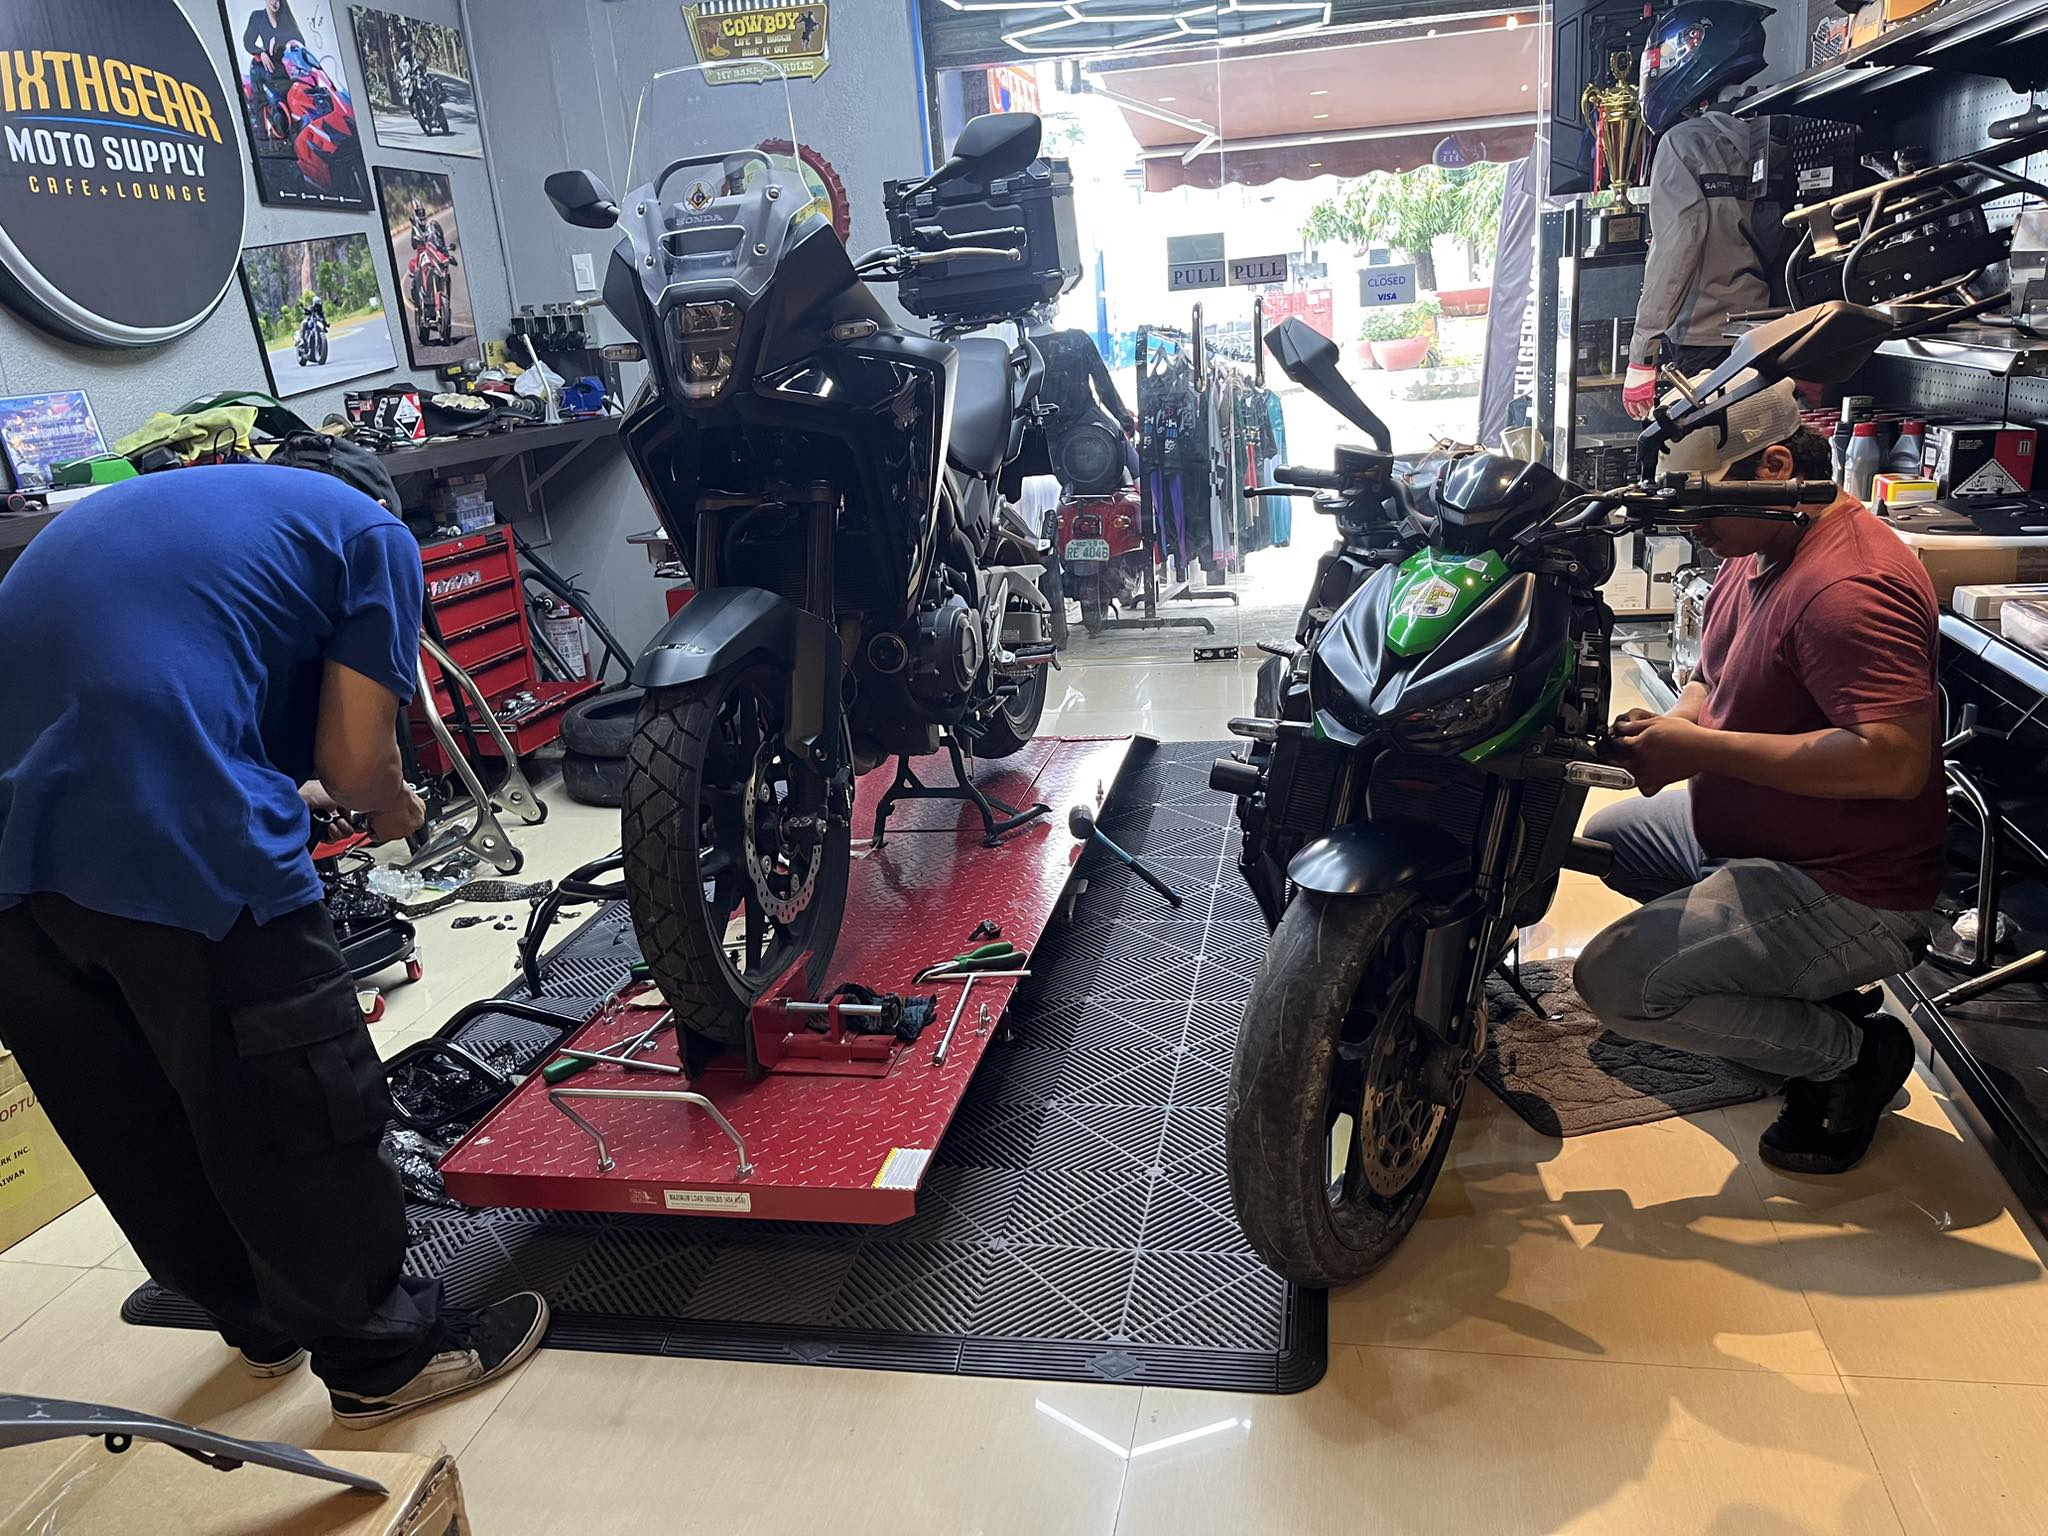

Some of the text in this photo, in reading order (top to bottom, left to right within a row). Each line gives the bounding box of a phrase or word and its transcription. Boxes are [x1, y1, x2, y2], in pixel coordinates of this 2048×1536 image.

[722, 12, 799, 37] COWBOY
[734, 37, 751, 47] LIFE
[755, 36, 763, 45] IS
[763, 46, 771, 55] IT
[774, 45, 789, 54] OUT
[0, 50, 223, 144] IXTHGEAR
[4, 125, 205, 177] MOTO SUPPLY
[676, 214, 723, 226] HONDA
[1174, 268, 1220, 285] PULL
[1234, 262, 1282, 279] PULL
[1367, 276, 1406, 288] CLOSED
[1378, 292, 1397, 301] VISA
[1067, 547, 1080, 558] RE
[0, 1094, 39, 1122] OPTU
[0, 1146, 31, 1168] RK INC.
